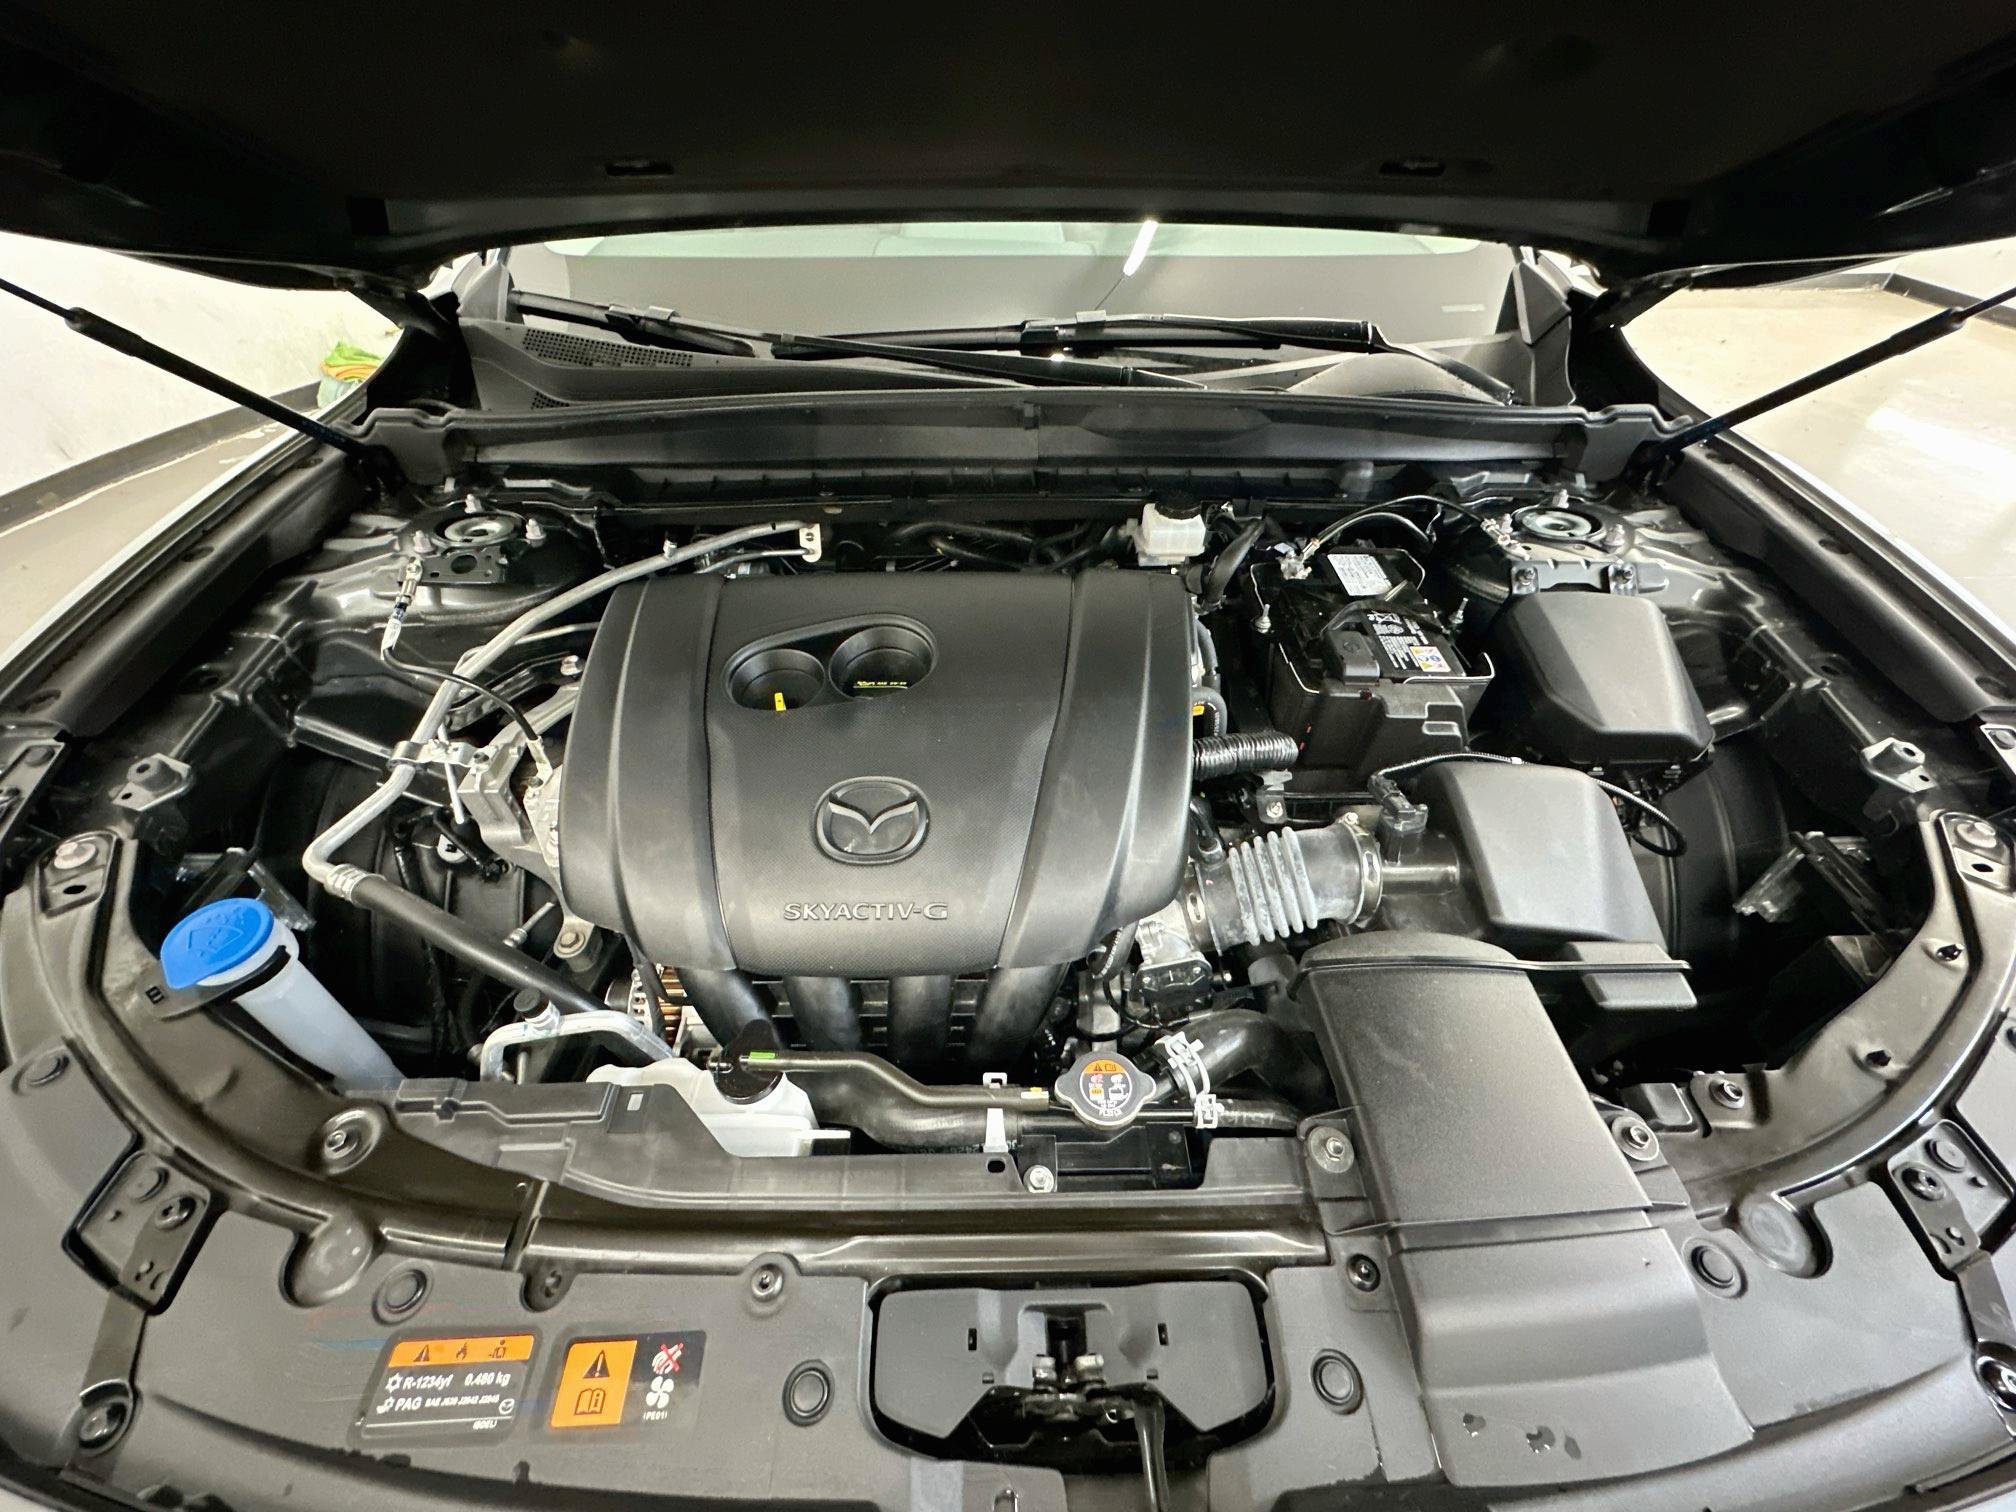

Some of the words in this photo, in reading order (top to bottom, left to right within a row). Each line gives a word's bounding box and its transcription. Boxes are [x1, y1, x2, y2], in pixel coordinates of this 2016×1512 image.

[783, 902, 949, 921] SKYACTIV-G
[495, 1370, 511, 1388] kg
[394, 1396, 422, 1411] PAG
